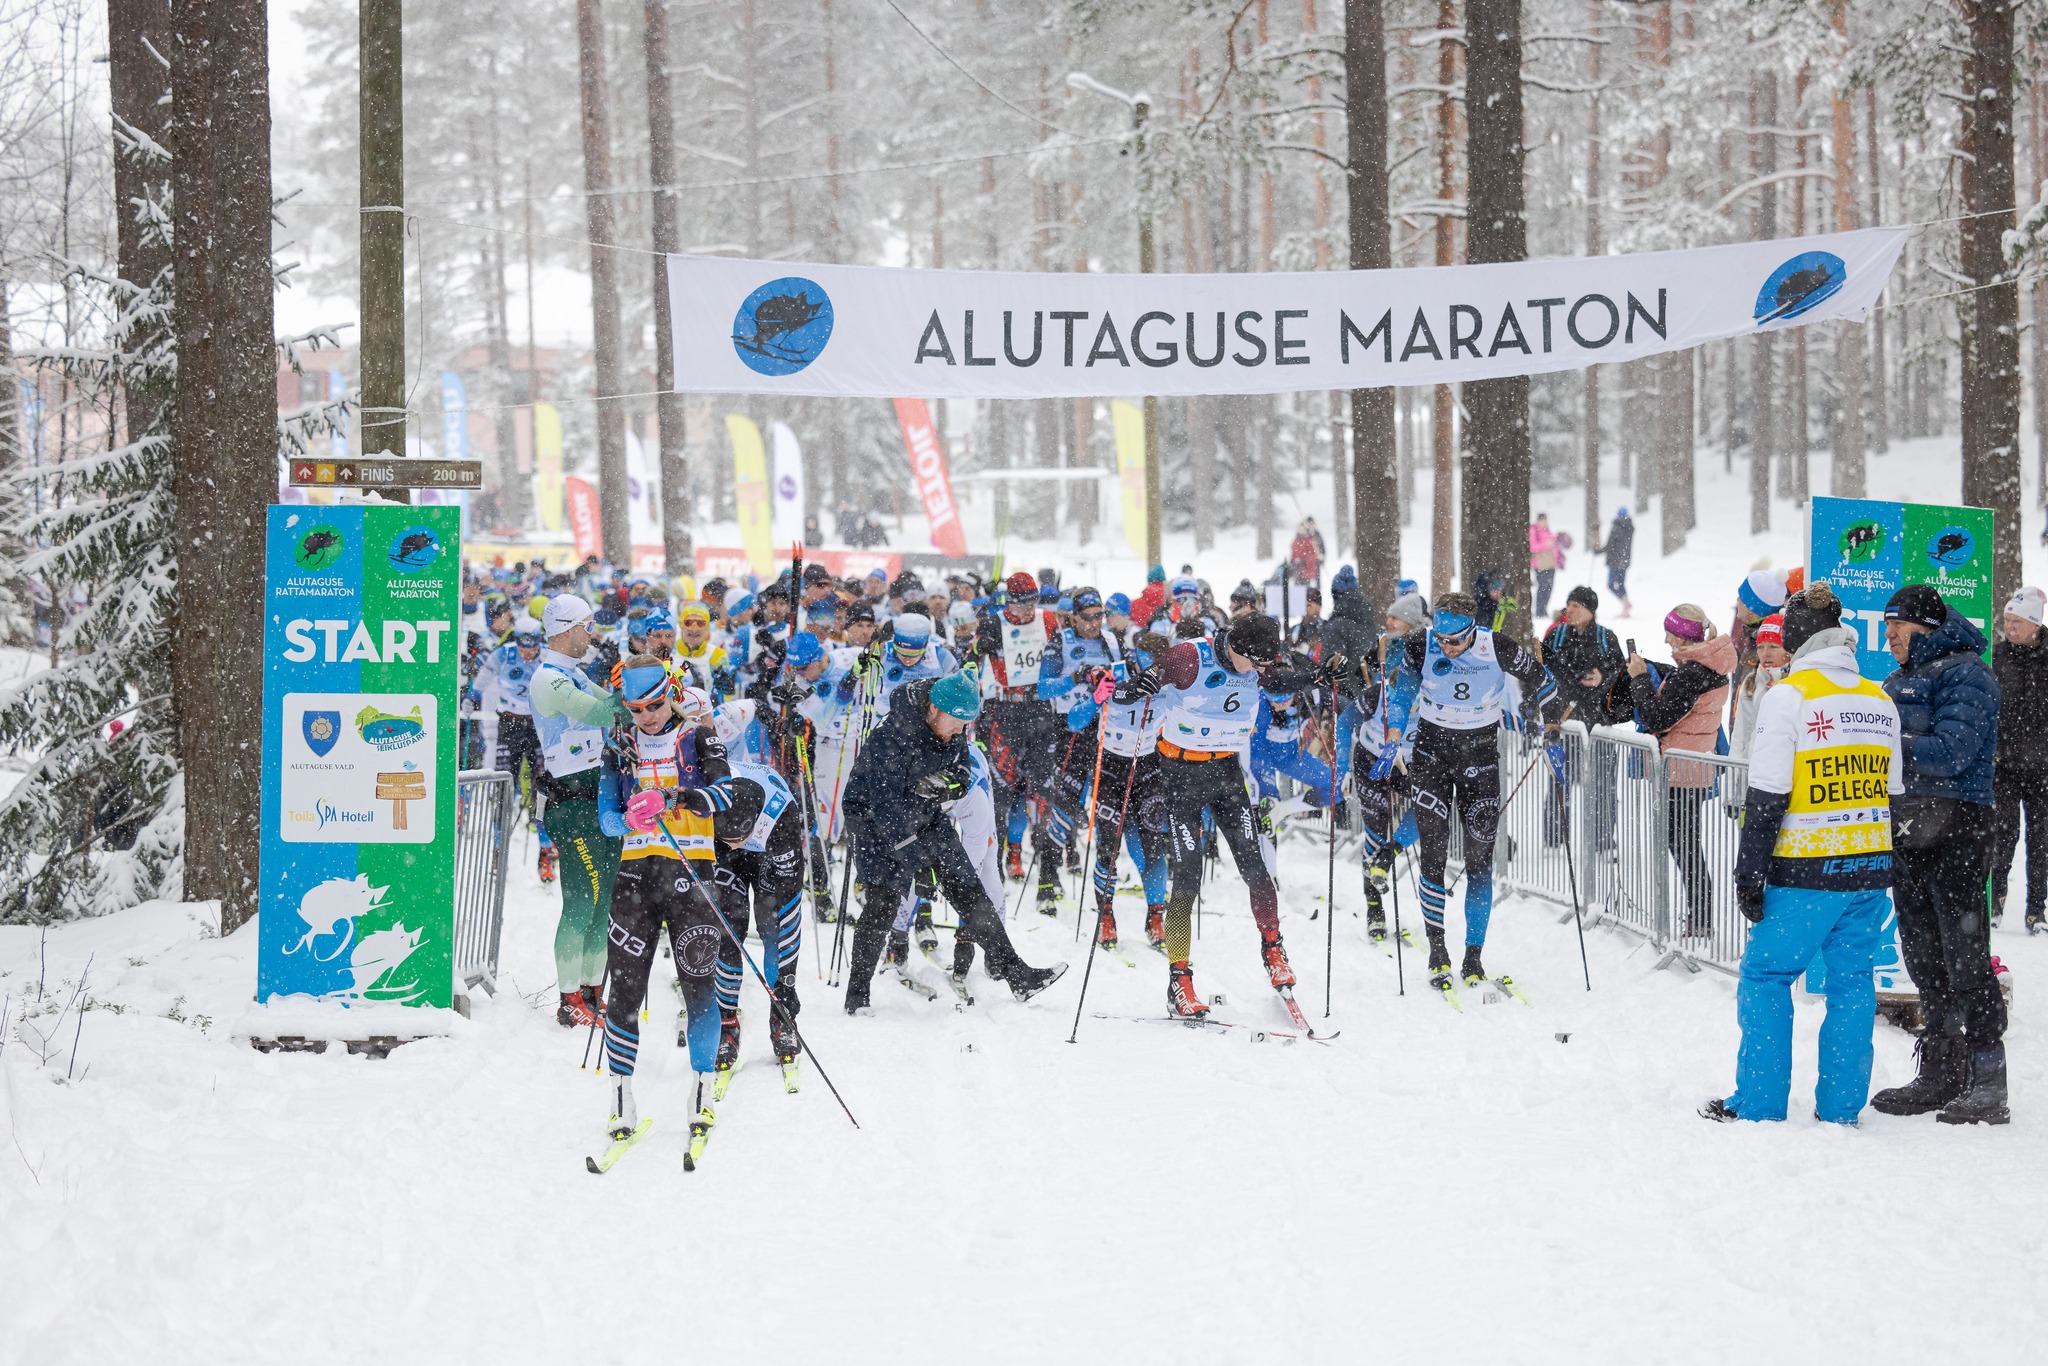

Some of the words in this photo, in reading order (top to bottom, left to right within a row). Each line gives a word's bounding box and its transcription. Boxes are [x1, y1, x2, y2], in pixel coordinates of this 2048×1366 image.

[914, 308, 1311, 369] ALUTAGUSE
[1340, 288, 1667, 364] MARATON
[361, 466, 395, 482] FINIŠ
[433, 469, 456, 482] 200
[461, 472, 474, 482] m
[1831, 568, 1885, 580] ALUTAGUSE
[286, 577, 344, 587] ALUTAGUSE
[386, 579, 444, 590] ALUTAGUSE
[1924, 576, 1978, 588] ALUTAGUSE
[275, 587, 355, 597] RATTAMARATON
[390, 590, 440, 599] MARATON
[282, 618, 450, 664] START
[1453, 682, 1471, 701] 8
[1223, 692, 1241, 713] 6
[369, 731, 412, 744] ALUTAGUSE
[644, 779, 665, 787] 203
[289, 811, 315, 822] Toila
[341, 811, 374, 822] Hotell
[1178, 823, 1196, 851] TOKO
[573, 837, 594, 871] Päidre
